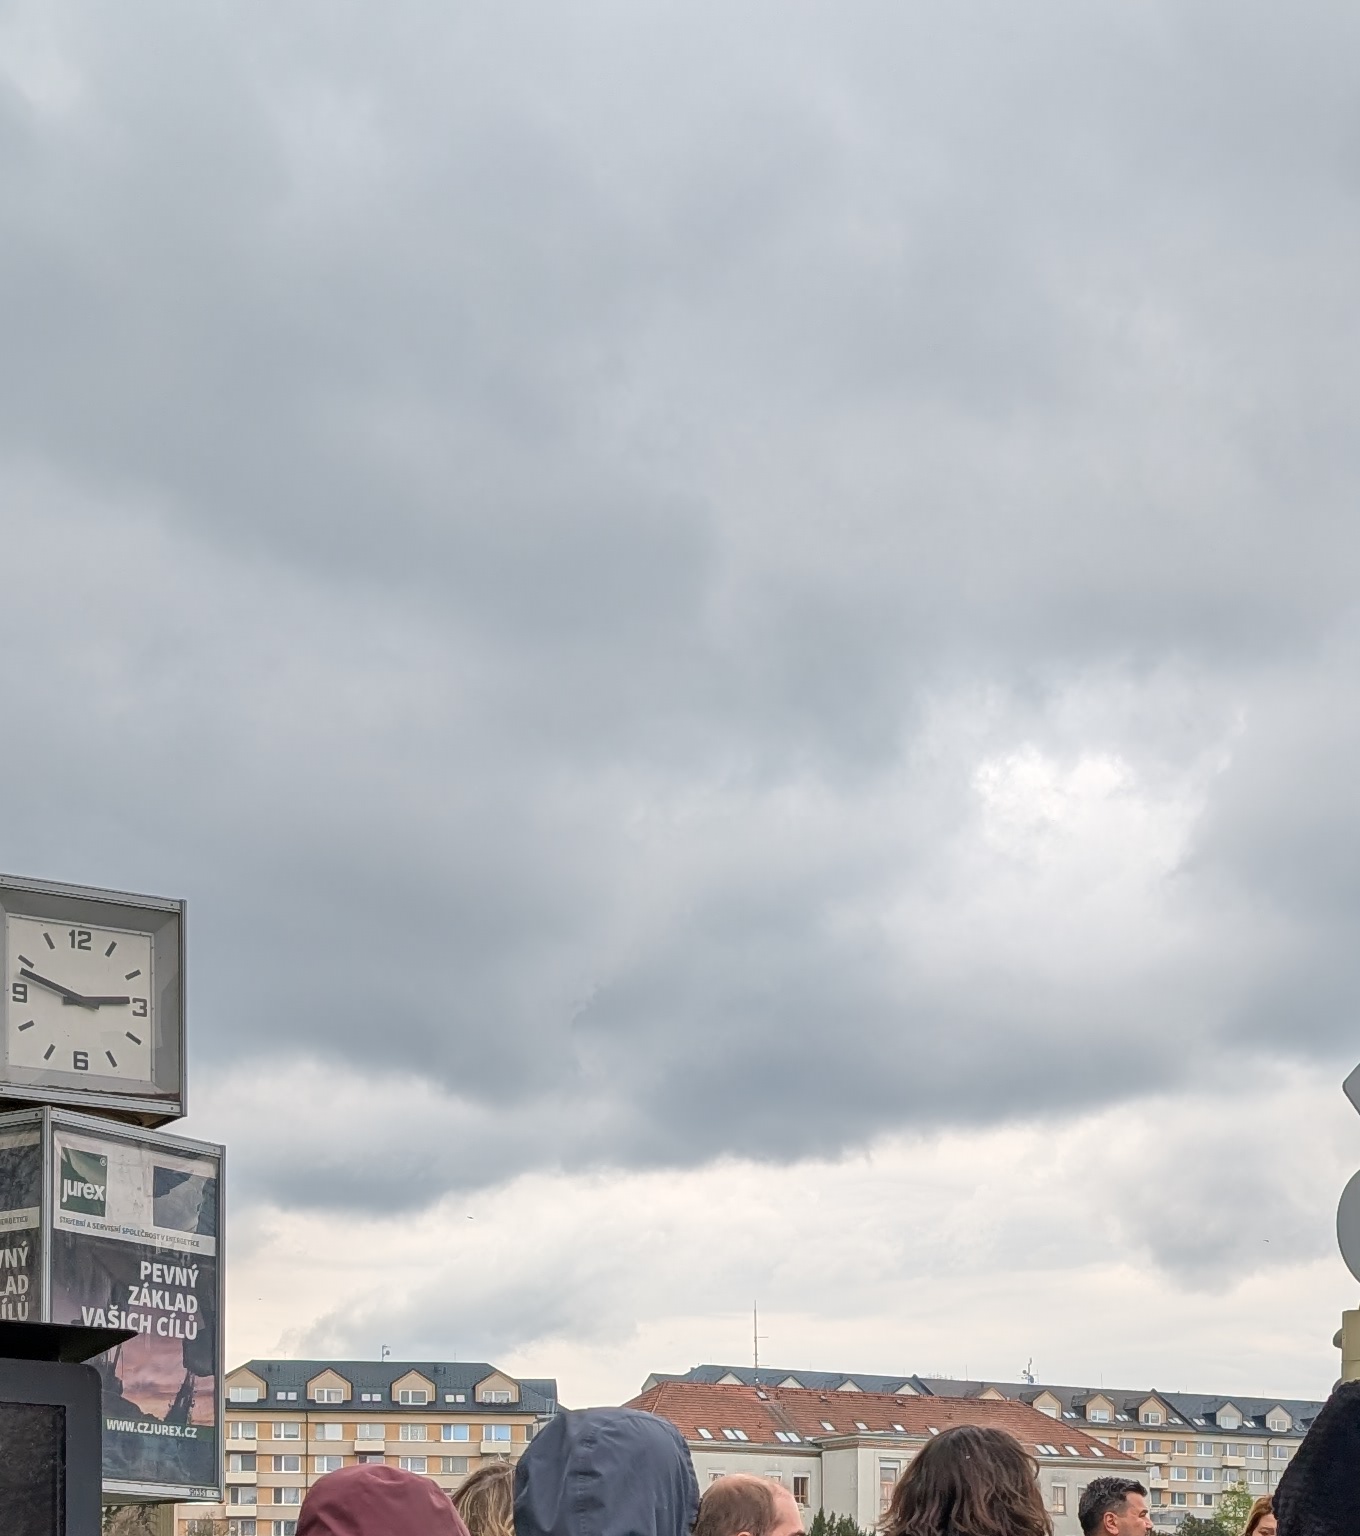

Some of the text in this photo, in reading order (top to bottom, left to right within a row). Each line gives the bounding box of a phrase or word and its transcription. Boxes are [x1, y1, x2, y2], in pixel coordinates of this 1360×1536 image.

[69, 929, 92, 951] 12
[12, 983, 28, 1004] 9
[132, 998, 148, 1018] 3
[73, 1051, 89, 1071] 6
[62, 1178, 105, 1203] jurex
[140, 1260, 200, 1289] PEVNÝ
[128, 1281, 198, 1314] ZÁKLAD
[81, 1304, 198, 1341] VAŠICH CÍLŮ
[106, 1418, 198, 1439] WWW.CZJUREX.CZ
